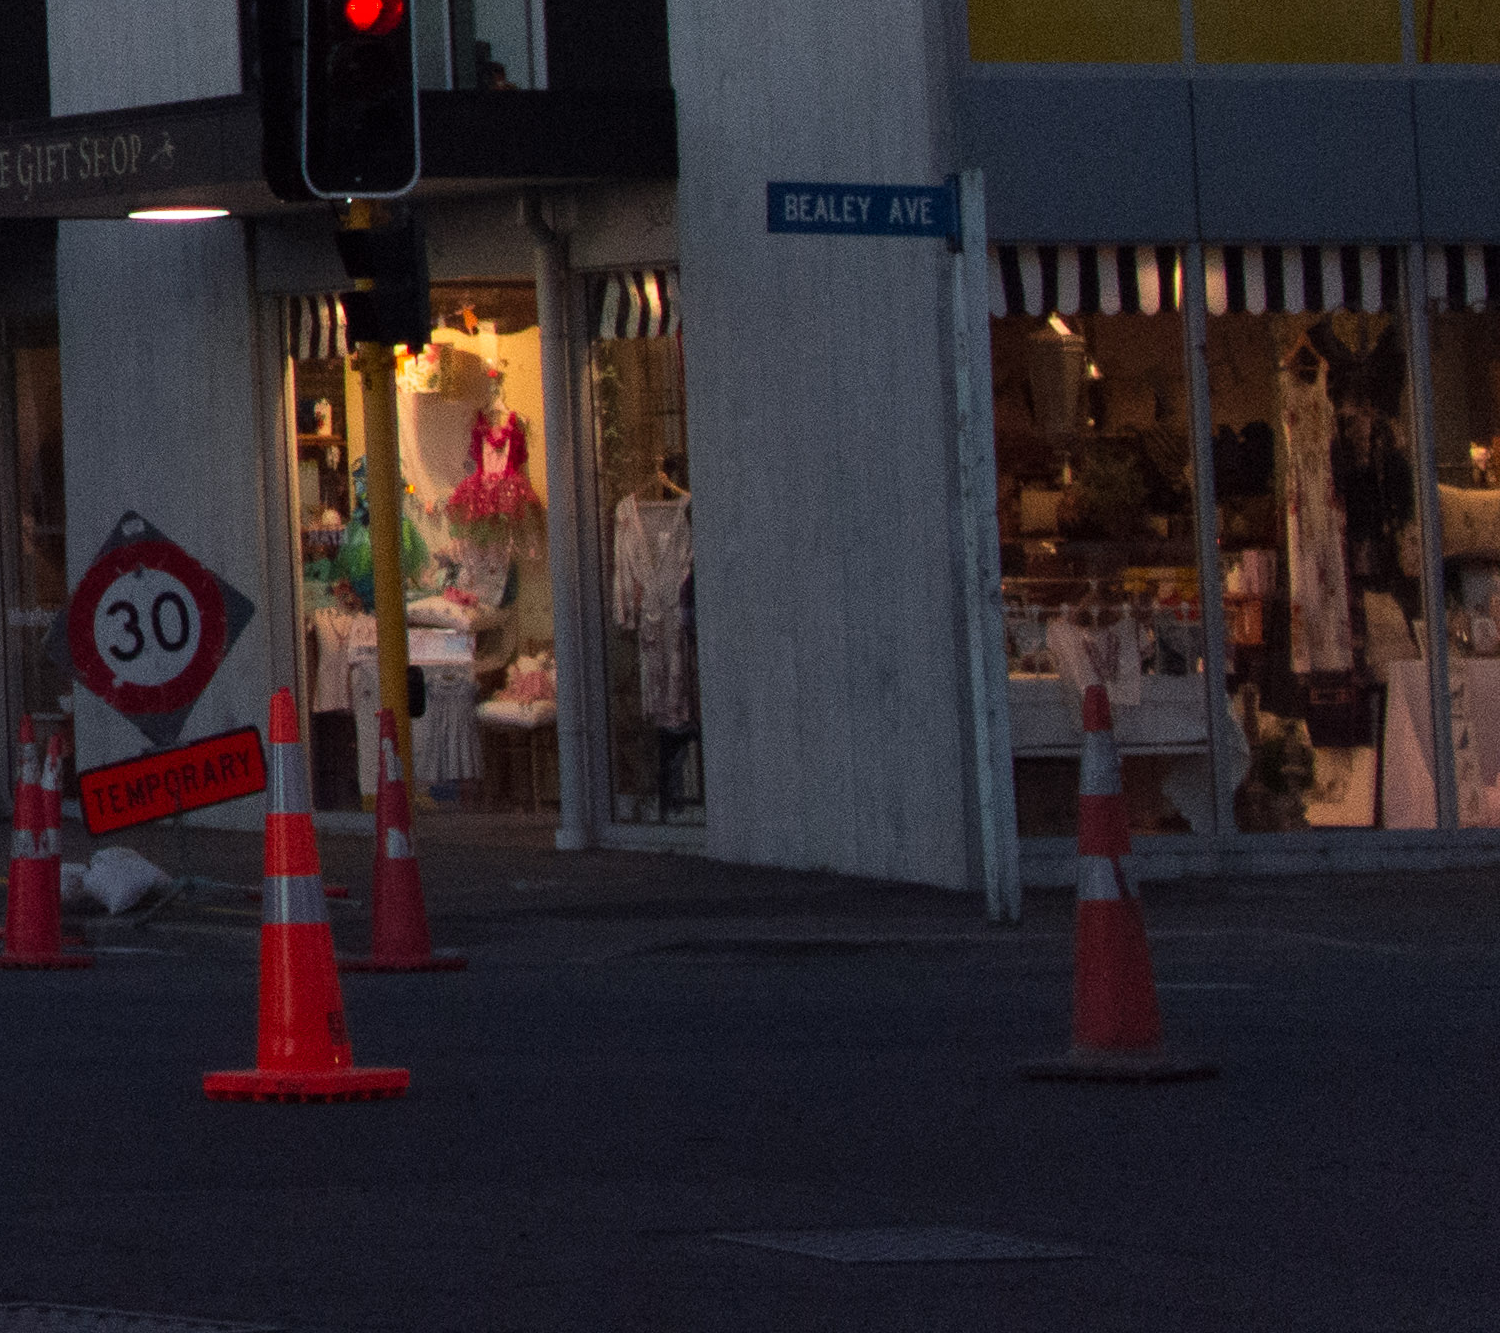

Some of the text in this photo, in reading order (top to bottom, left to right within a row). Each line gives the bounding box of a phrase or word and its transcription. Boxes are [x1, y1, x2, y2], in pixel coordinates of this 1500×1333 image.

[17, 143, 72, 201] GIFT
[78, 134, 143, 180] SHOP
[784, 194, 935, 226] BEALEY AVE
[107, 592, 190, 661] 30
[91, 748, 253, 816] TEMPORARY
